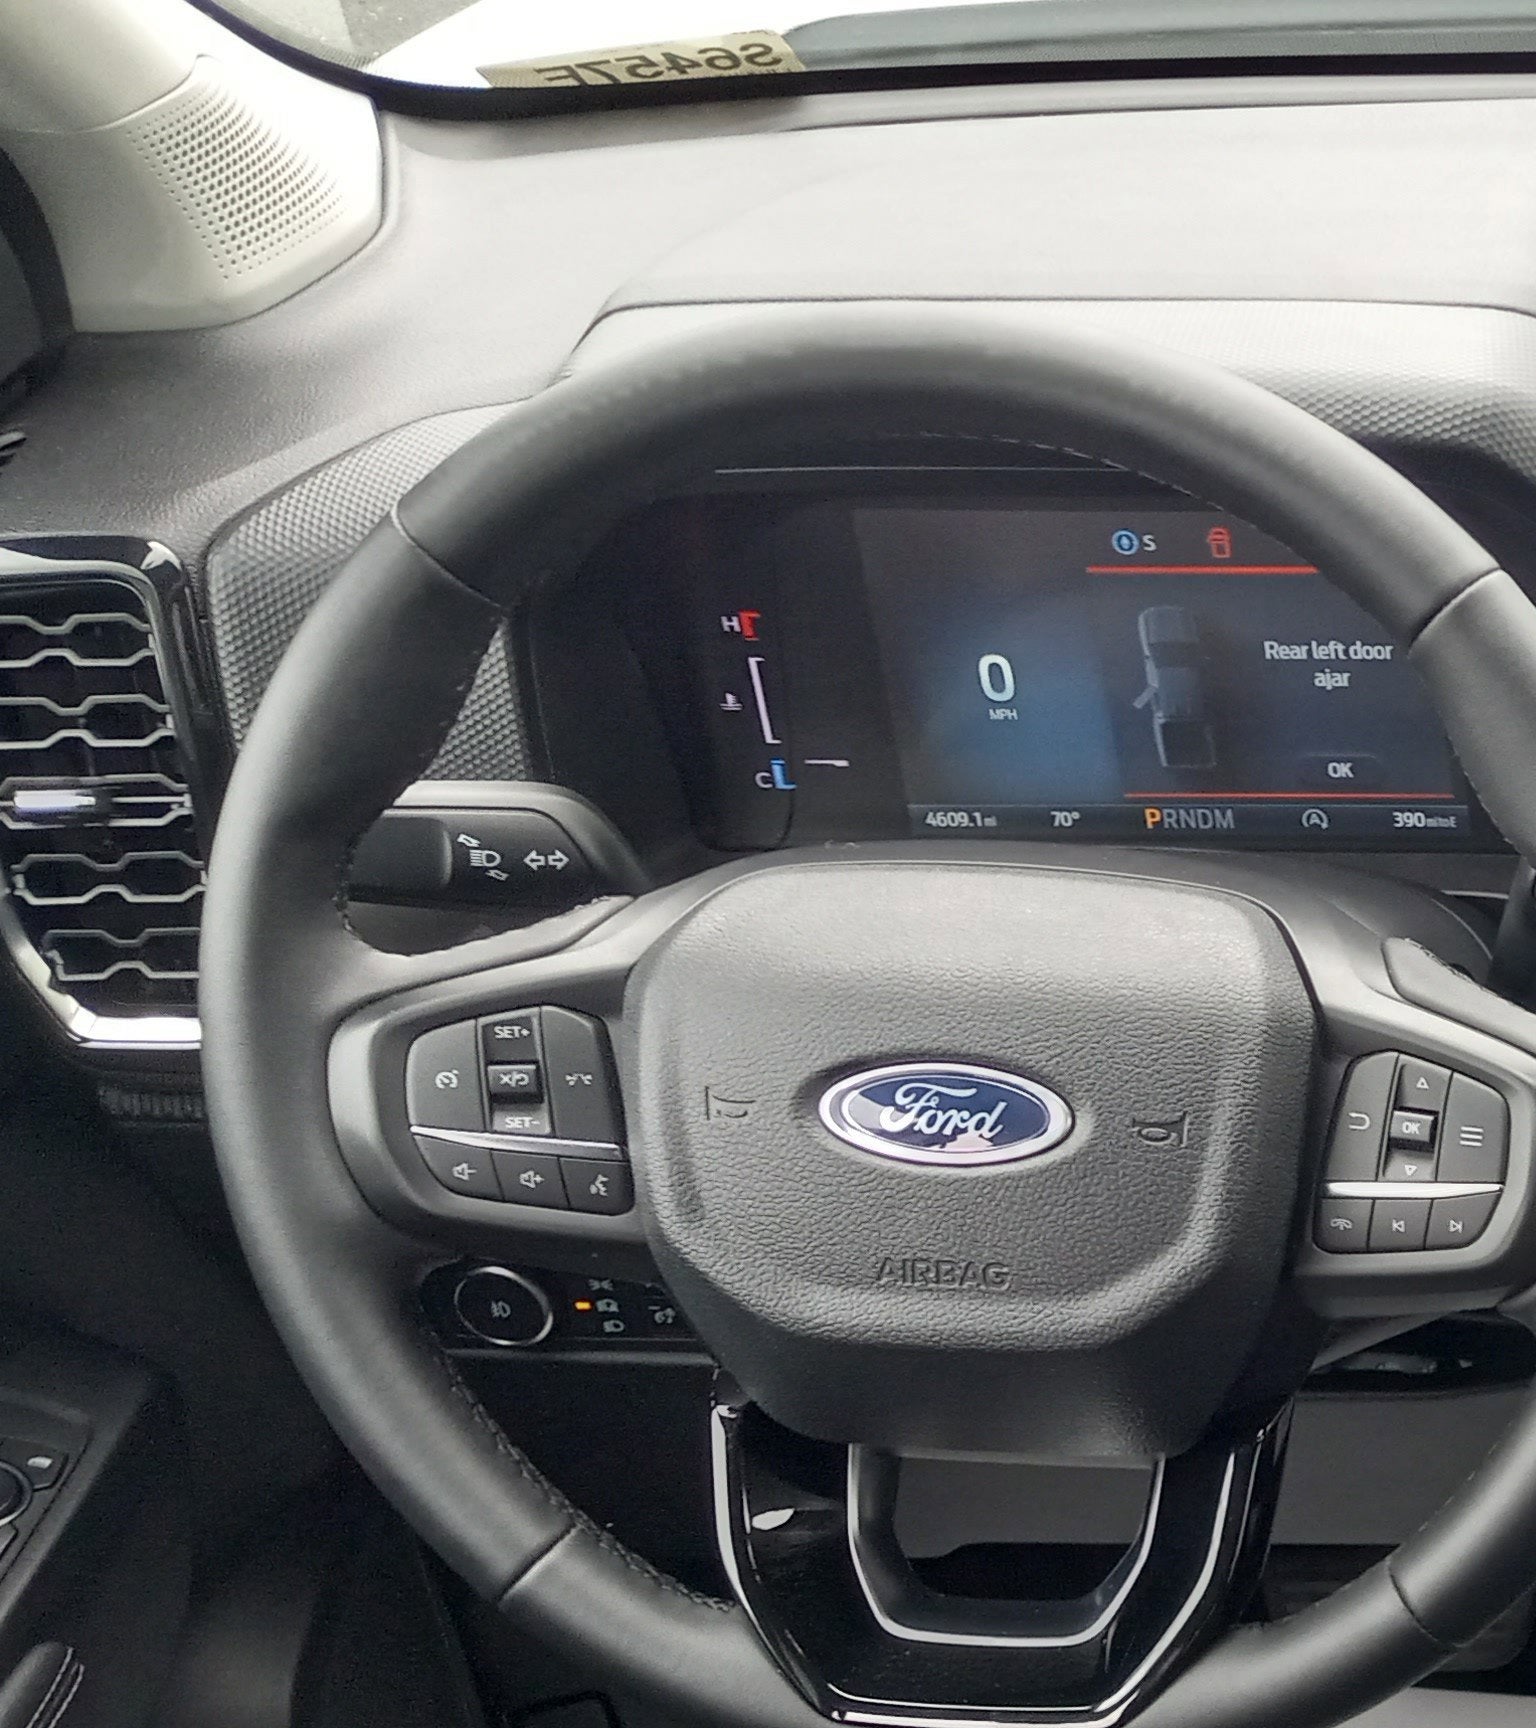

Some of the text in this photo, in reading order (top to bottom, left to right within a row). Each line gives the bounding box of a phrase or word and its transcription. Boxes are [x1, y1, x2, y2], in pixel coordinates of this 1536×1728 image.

[1263, 640, 1393, 661] Rear left door
[978, 653, 1016, 703] 0
[1314, 668, 1350, 690] ajar
[988, 709, 1018, 721] MPH
[1328, 762, 1353, 778] OK
[1050, 811, 1080, 827] 70°
[879, 1082, 1007, 1141] Ford
[1401, 1121, 1420, 1135] OK
[875, 1257, 1011, 1290] AIRBAG
